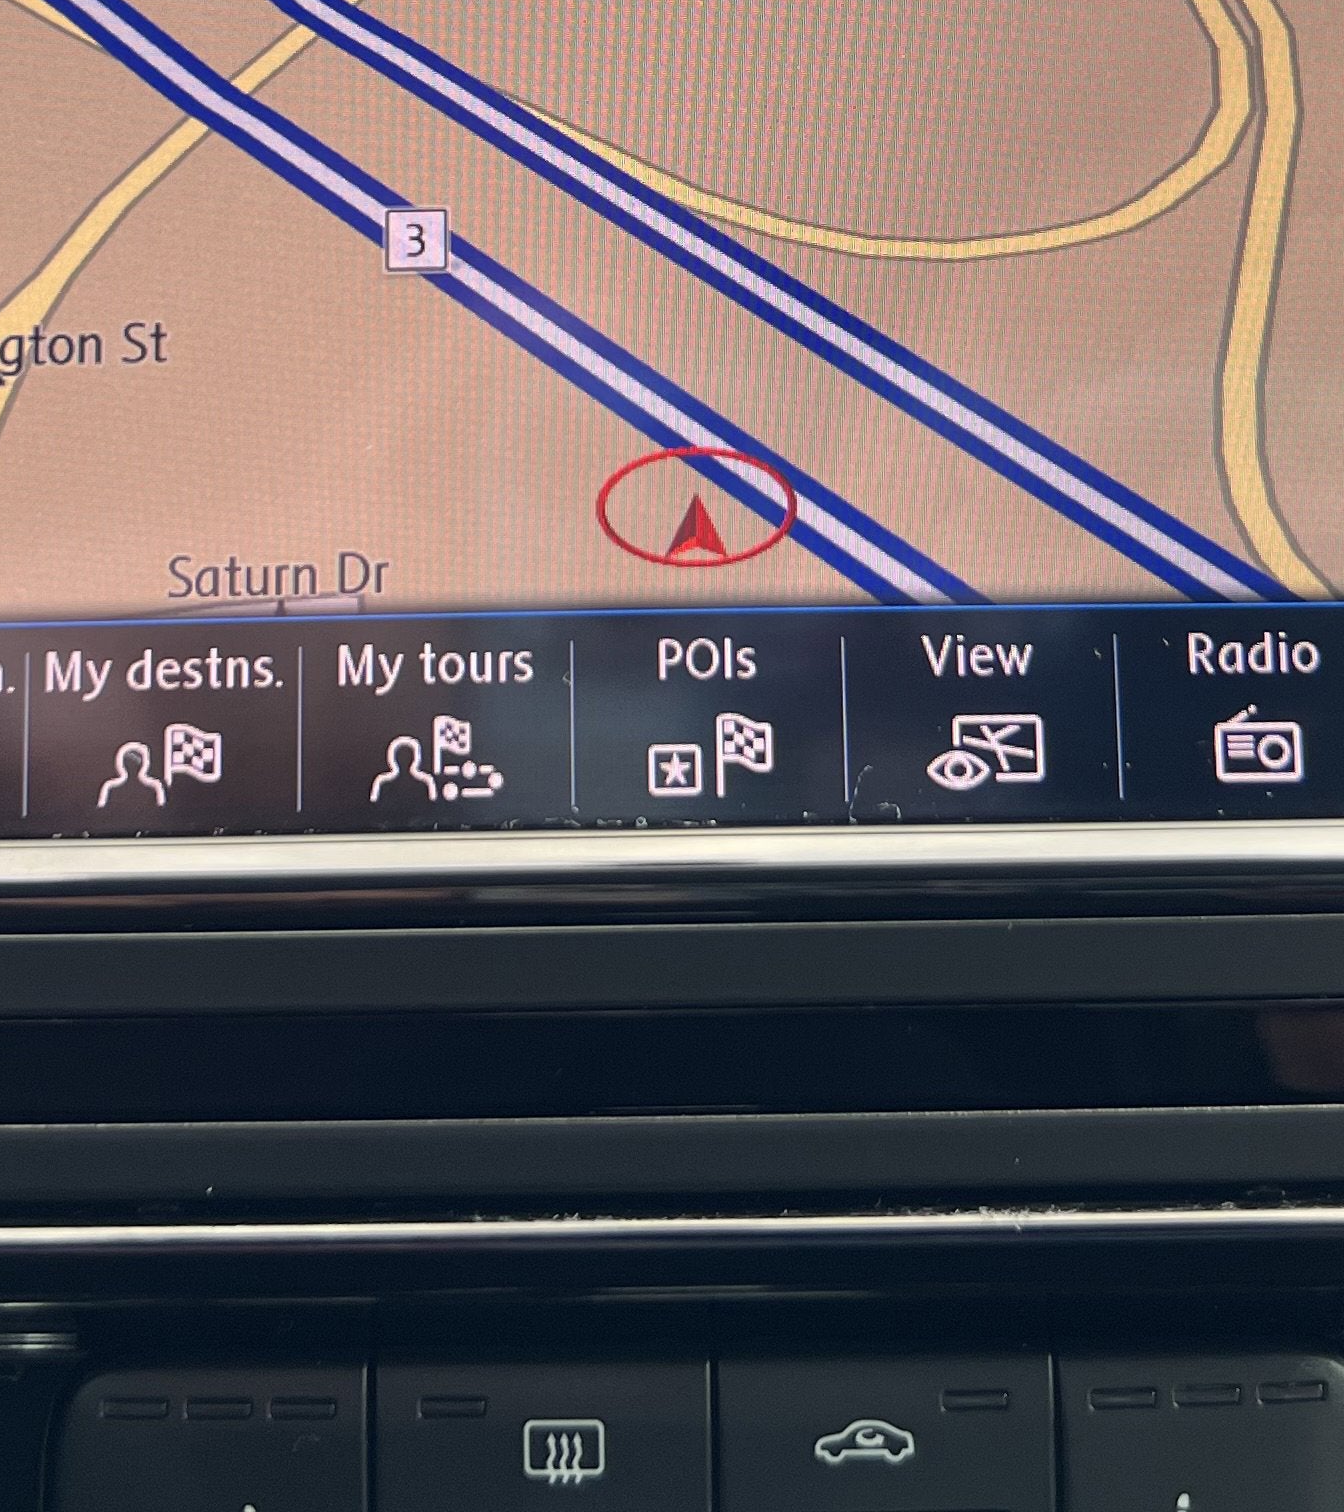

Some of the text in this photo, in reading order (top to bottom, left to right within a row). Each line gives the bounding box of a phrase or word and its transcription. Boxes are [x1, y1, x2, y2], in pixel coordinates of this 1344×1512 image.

[405, 223, 426, 257] 3
[121, 323, 168, 363] St
[168, 553, 390, 598] Saturn Dr
[45, 646, 284, 701] My destns.
[337, 643, 534, 694] My tours
[657, 637, 758, 680] POIs
[922, 635, 1033, 678] View
[1187, 632, 1320, 674] Radio
